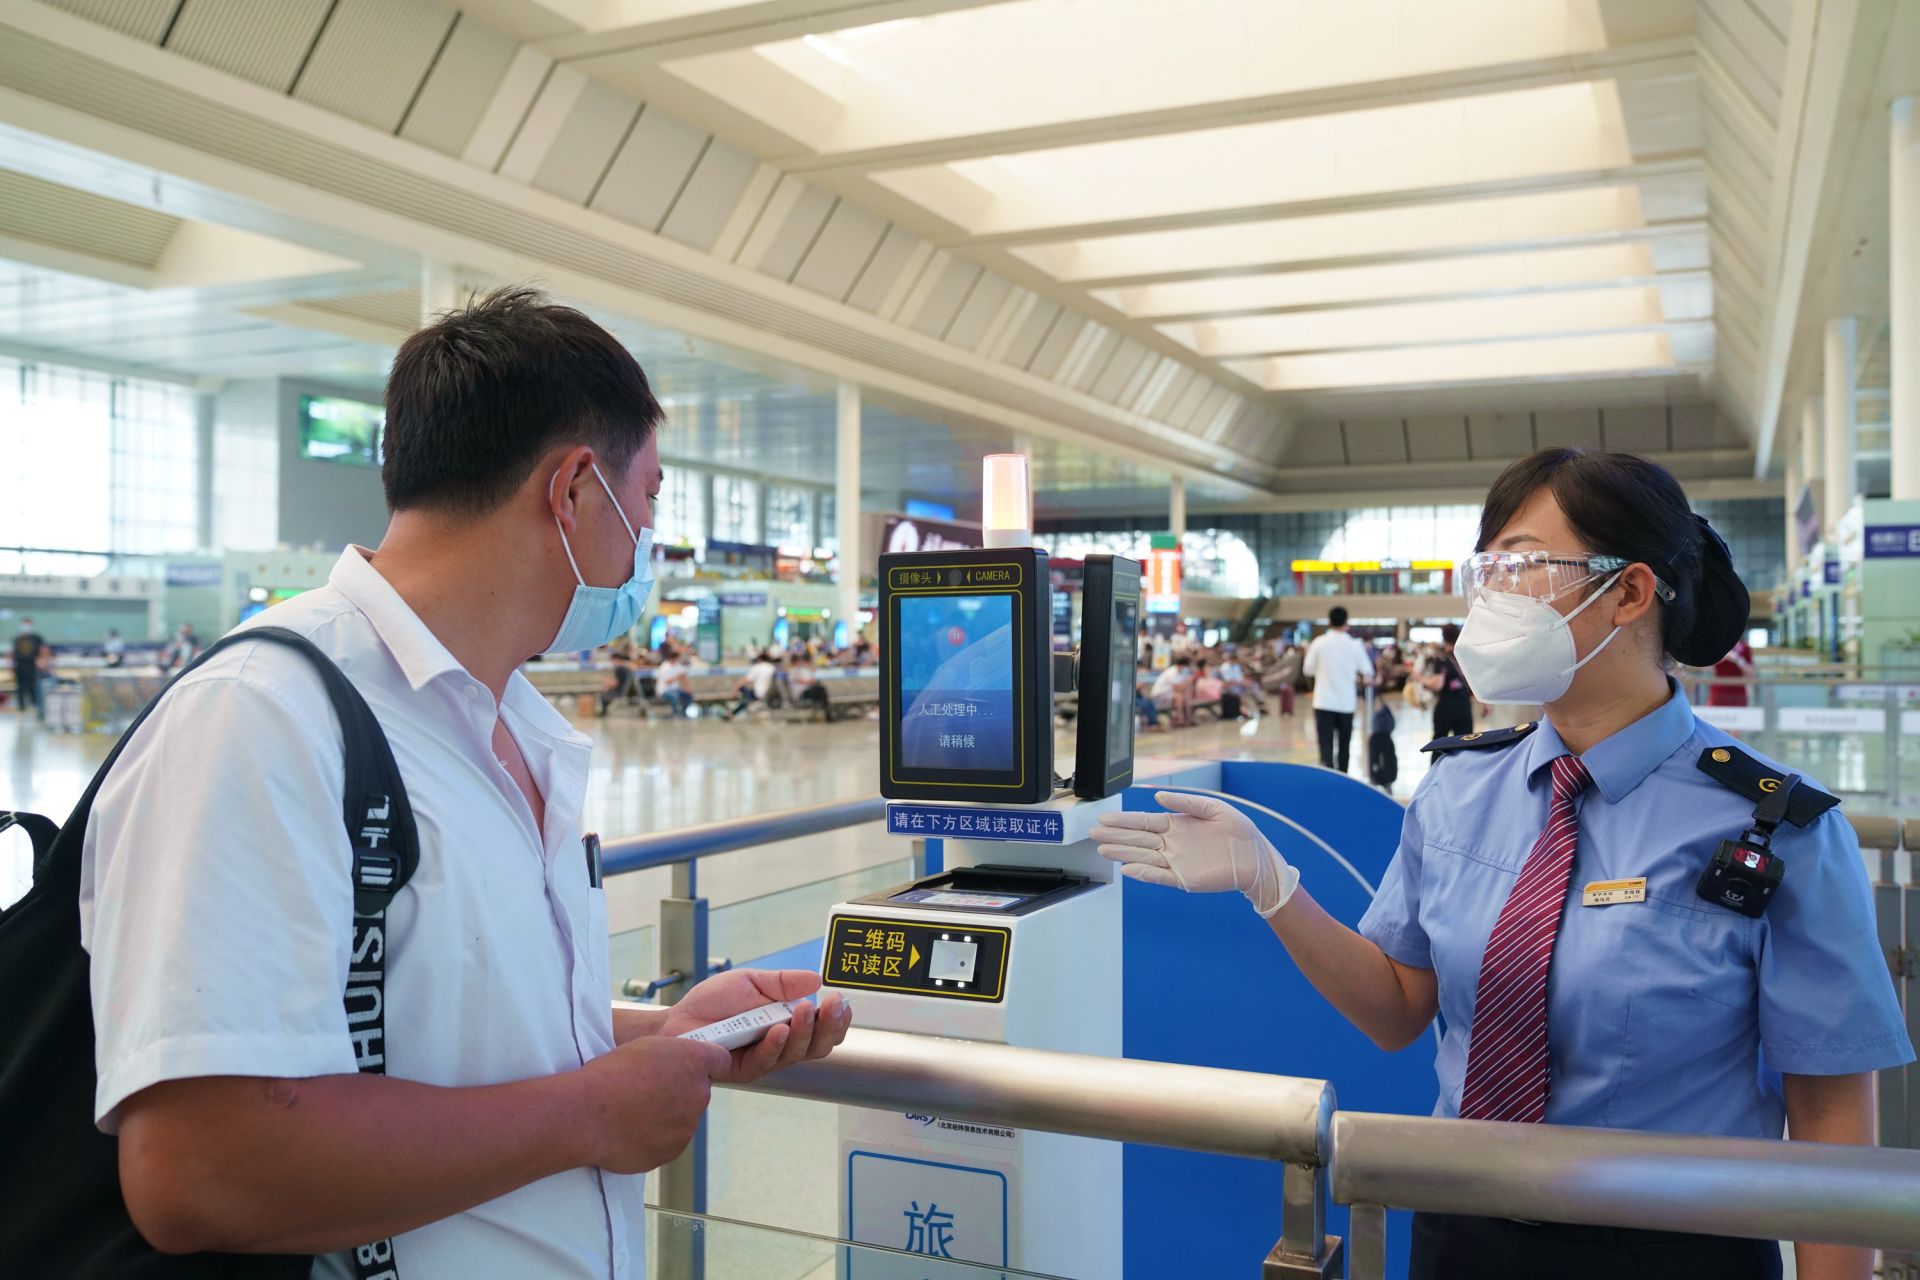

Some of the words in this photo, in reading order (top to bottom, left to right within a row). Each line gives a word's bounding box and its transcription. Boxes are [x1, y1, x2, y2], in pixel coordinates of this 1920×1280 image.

[899, 572, 932, 585] 摄像头
[975, 571, 1010, 582] CAMERA
[939, 734, 976, 749] 请稍候
[894, 812, 1059, 836] 请在下方区域读取证件
[844, 928, 905, 953] 二维码
[840, 952, 902, 977] 识读区
